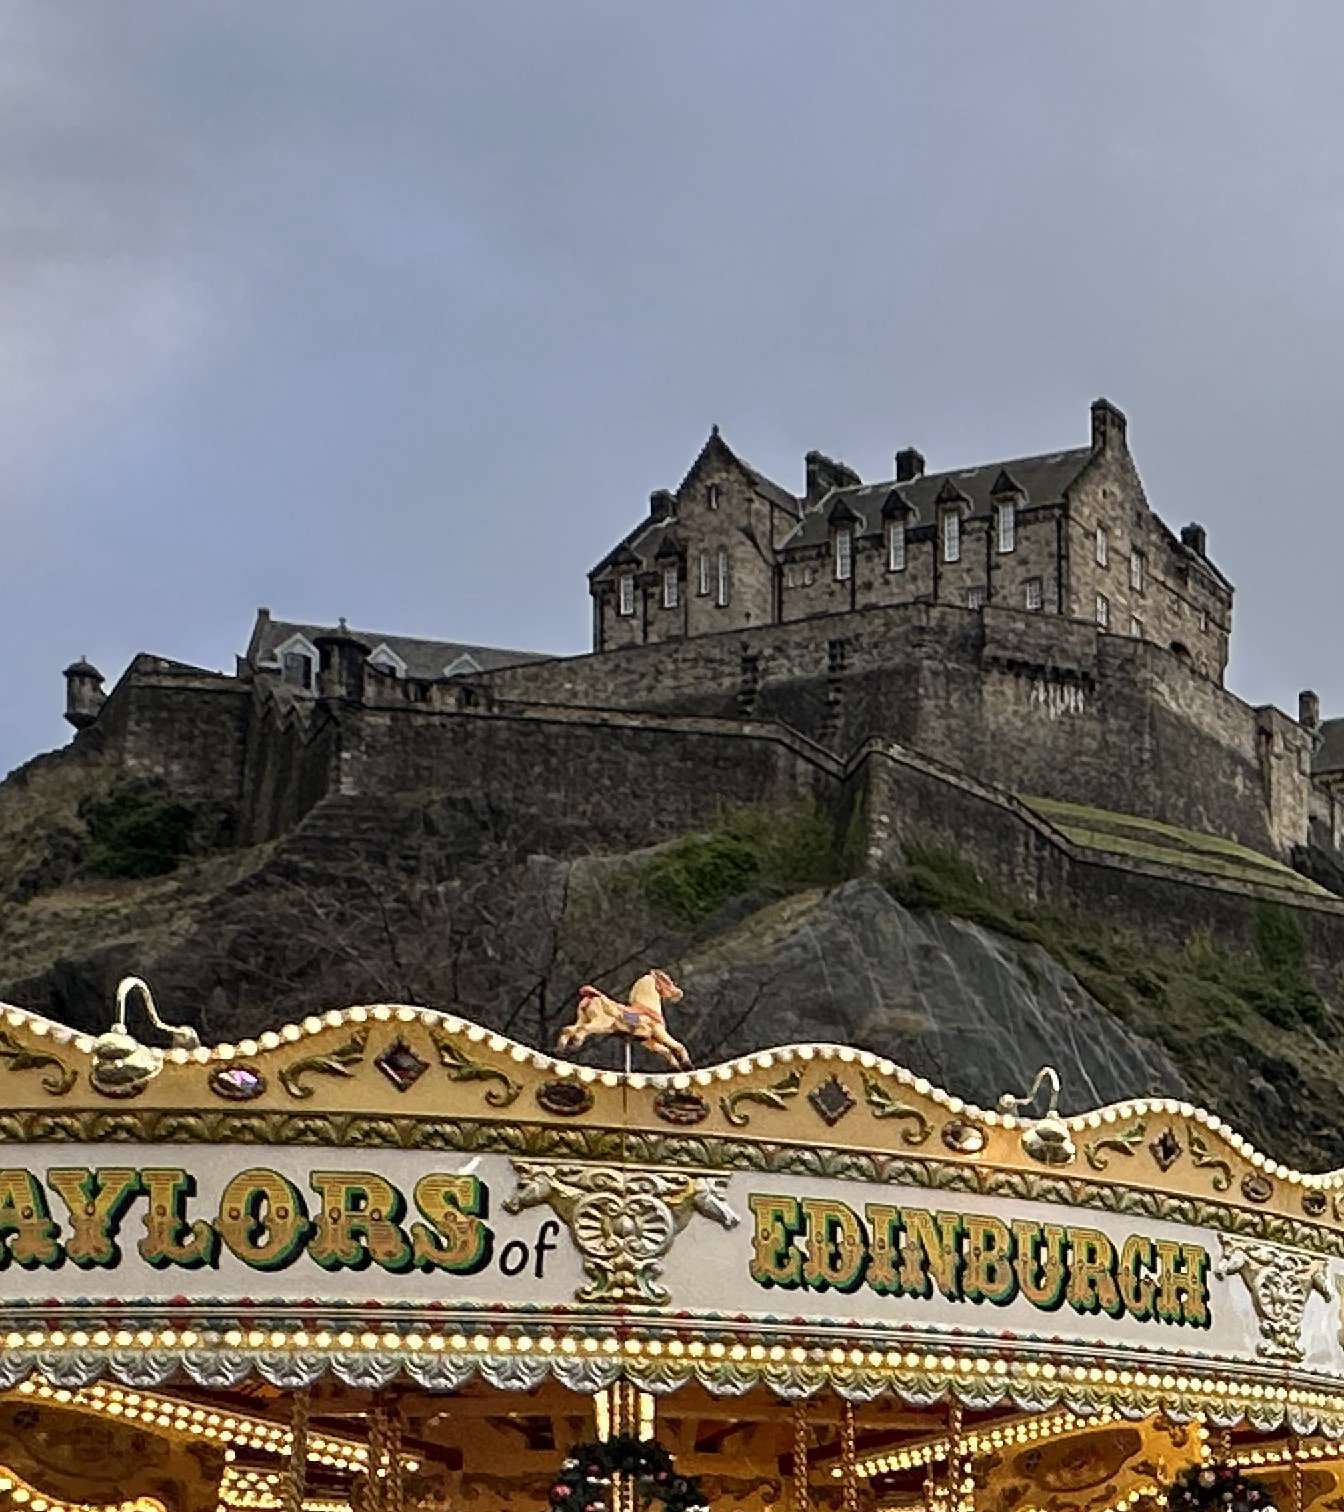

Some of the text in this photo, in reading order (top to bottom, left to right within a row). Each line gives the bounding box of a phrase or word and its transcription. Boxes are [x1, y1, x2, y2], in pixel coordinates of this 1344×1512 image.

[0, 1164, 491, 1275] AYLORS
[500, 1219, 558, 1278] of
[747, 1192, 1212, 1330] EDINBURGH
